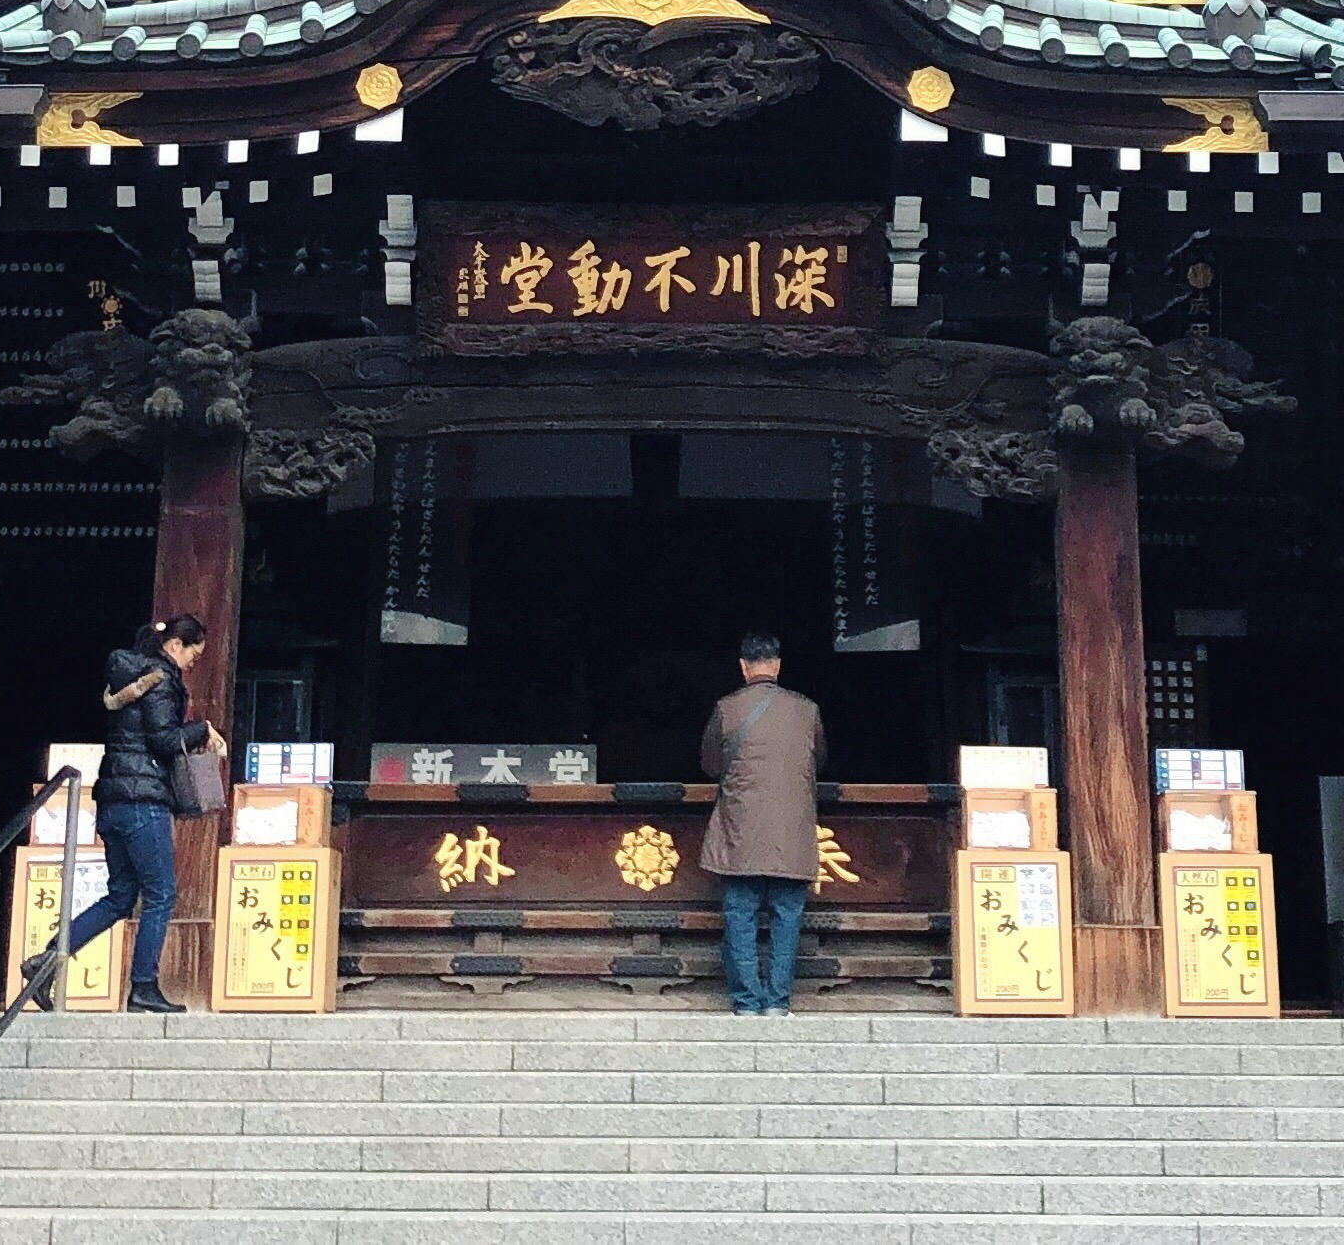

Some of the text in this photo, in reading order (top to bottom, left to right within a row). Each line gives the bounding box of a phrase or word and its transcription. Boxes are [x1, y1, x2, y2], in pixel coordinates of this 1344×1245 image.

[500, 240, 835, 316] 深川不動堂
[433, 825, 516, 894] 納
[238, 886, 304, 989] おみくじ
[979, 888, 1053, 992] おみくじ
[1183, 892, 1257, 996] おみくじ
